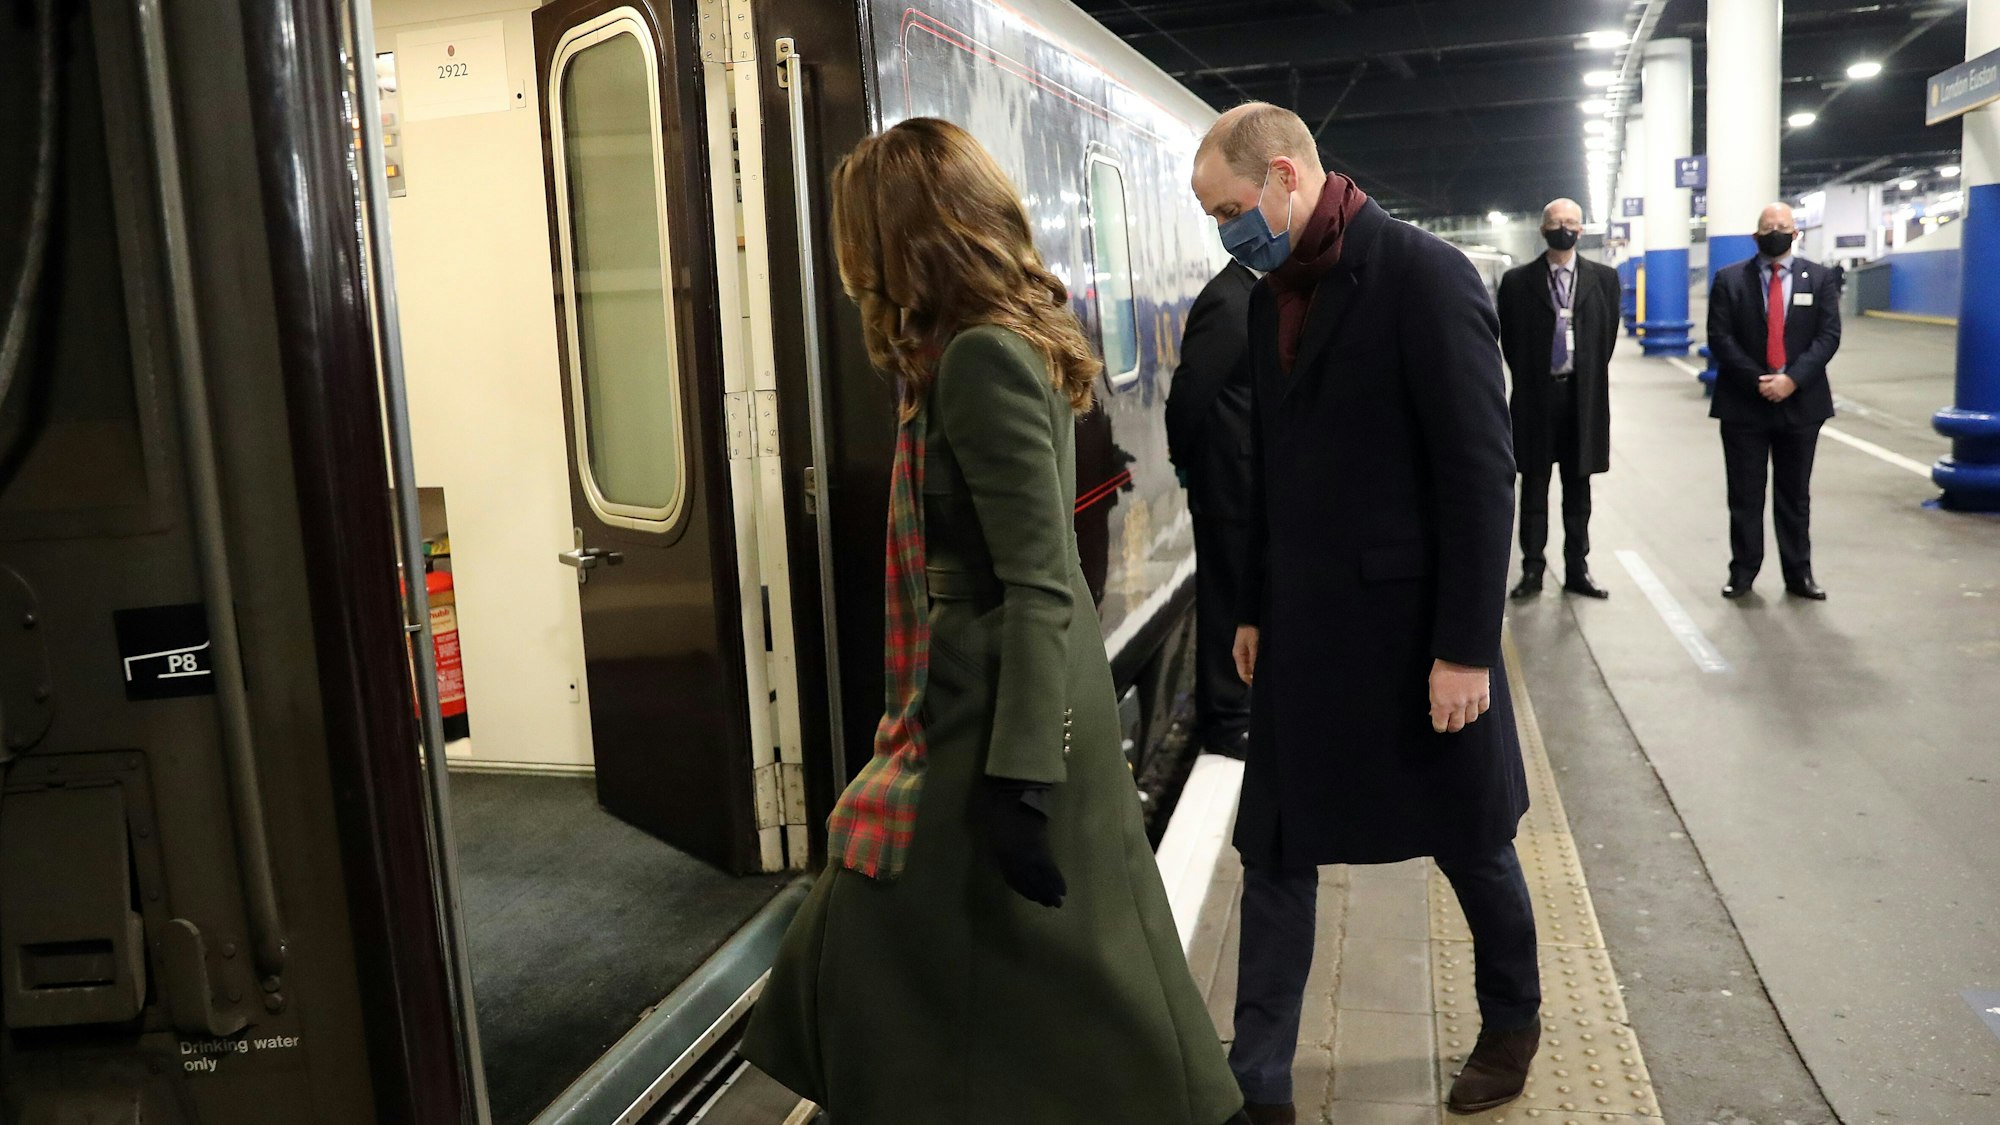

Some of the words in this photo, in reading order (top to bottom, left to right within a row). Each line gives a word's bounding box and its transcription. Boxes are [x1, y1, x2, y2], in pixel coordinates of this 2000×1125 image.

[437, 62, 469, 79] 2922
[1940, 75, 1969, 103] London
[1969, 65, 1997, 91] Euston
[429, 608, 450, 619] hubb
[167, 653, 198, 673] P8
[180, 1039, 249, 1055] Drinking
[253, 1035, 299, 1050] water
[183, 1056, 218, 1072] only
